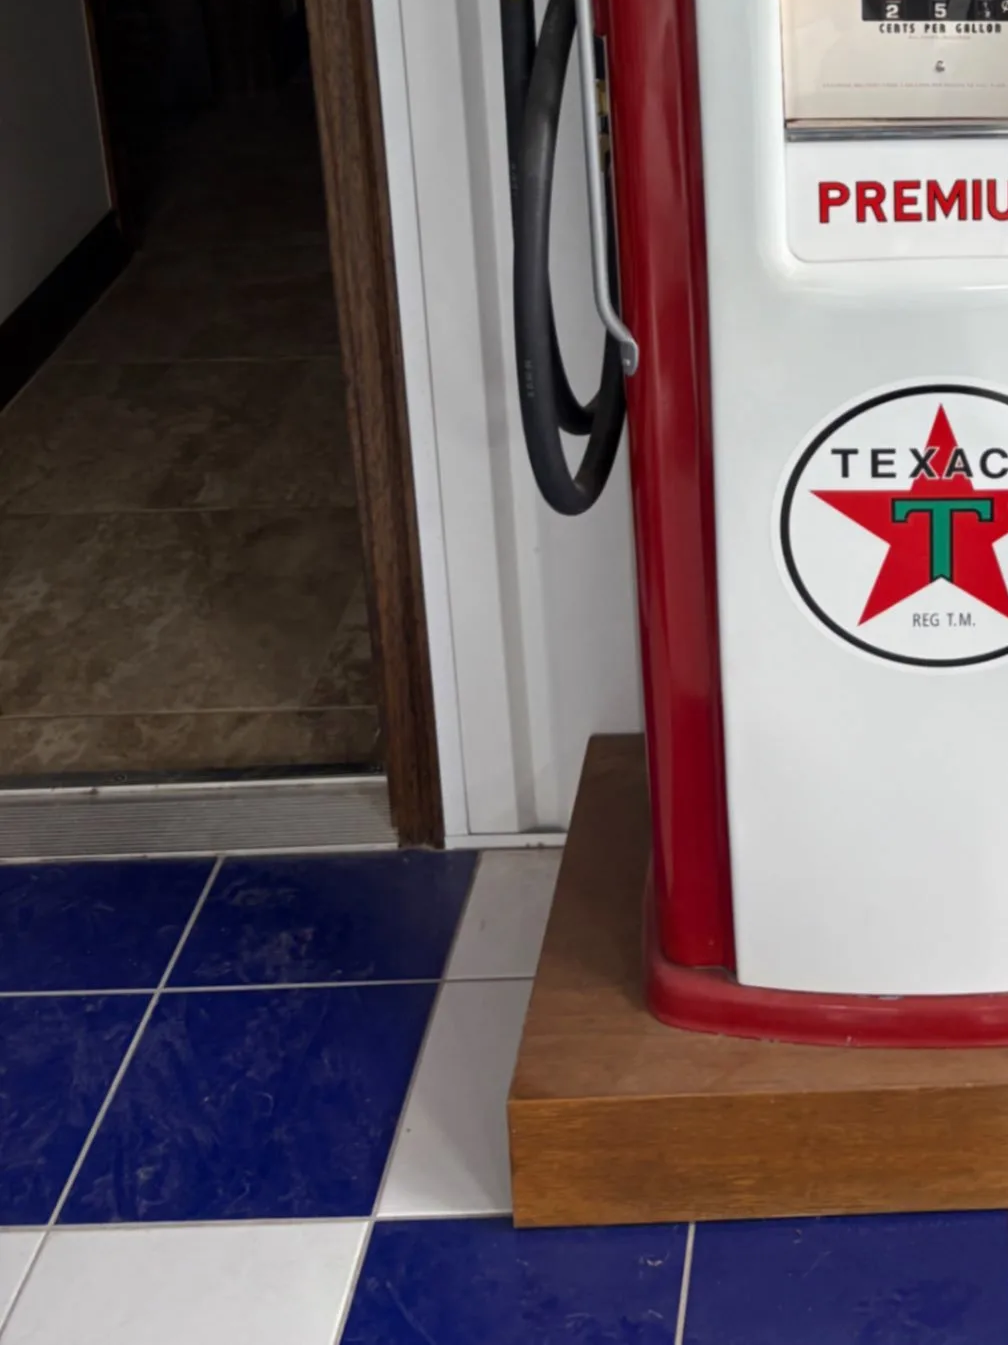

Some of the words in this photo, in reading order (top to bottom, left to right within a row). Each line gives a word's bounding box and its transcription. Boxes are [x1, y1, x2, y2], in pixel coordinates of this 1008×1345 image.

[934, 3, 947, 18] 5
[879, 23, 915, 33] CENTS
[924, 23, 946, 33] PER
[955, 23, 1002, 33] GALLON
[912, 613, 940, 627] REG
[947, 613, 976, 627] T.M.
